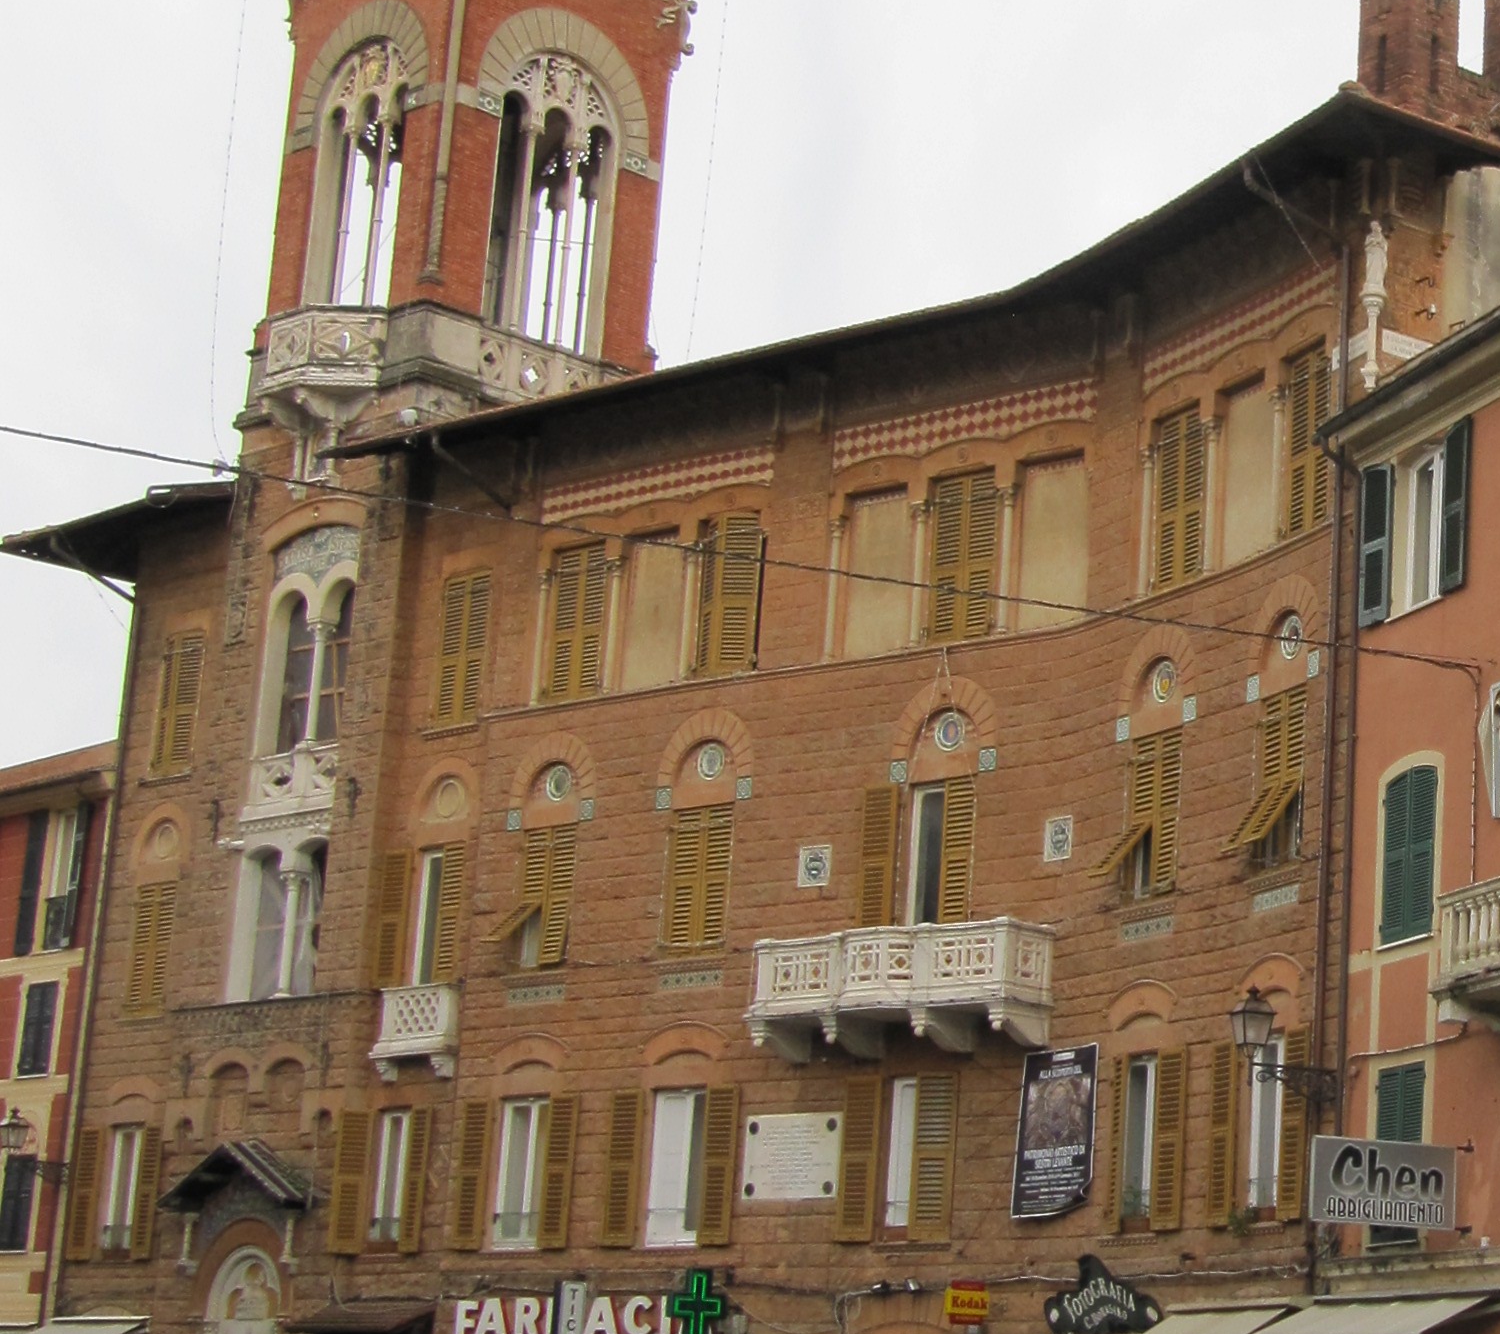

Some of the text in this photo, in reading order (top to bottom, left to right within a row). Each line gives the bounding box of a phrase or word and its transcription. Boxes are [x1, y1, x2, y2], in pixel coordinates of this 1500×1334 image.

[1331, 1143, 1444, 1201] Chen
[1326, 1197, 1444, 1224] ABBIGLIAMENTO
[952, 1296, 988, 1310] Kodak
